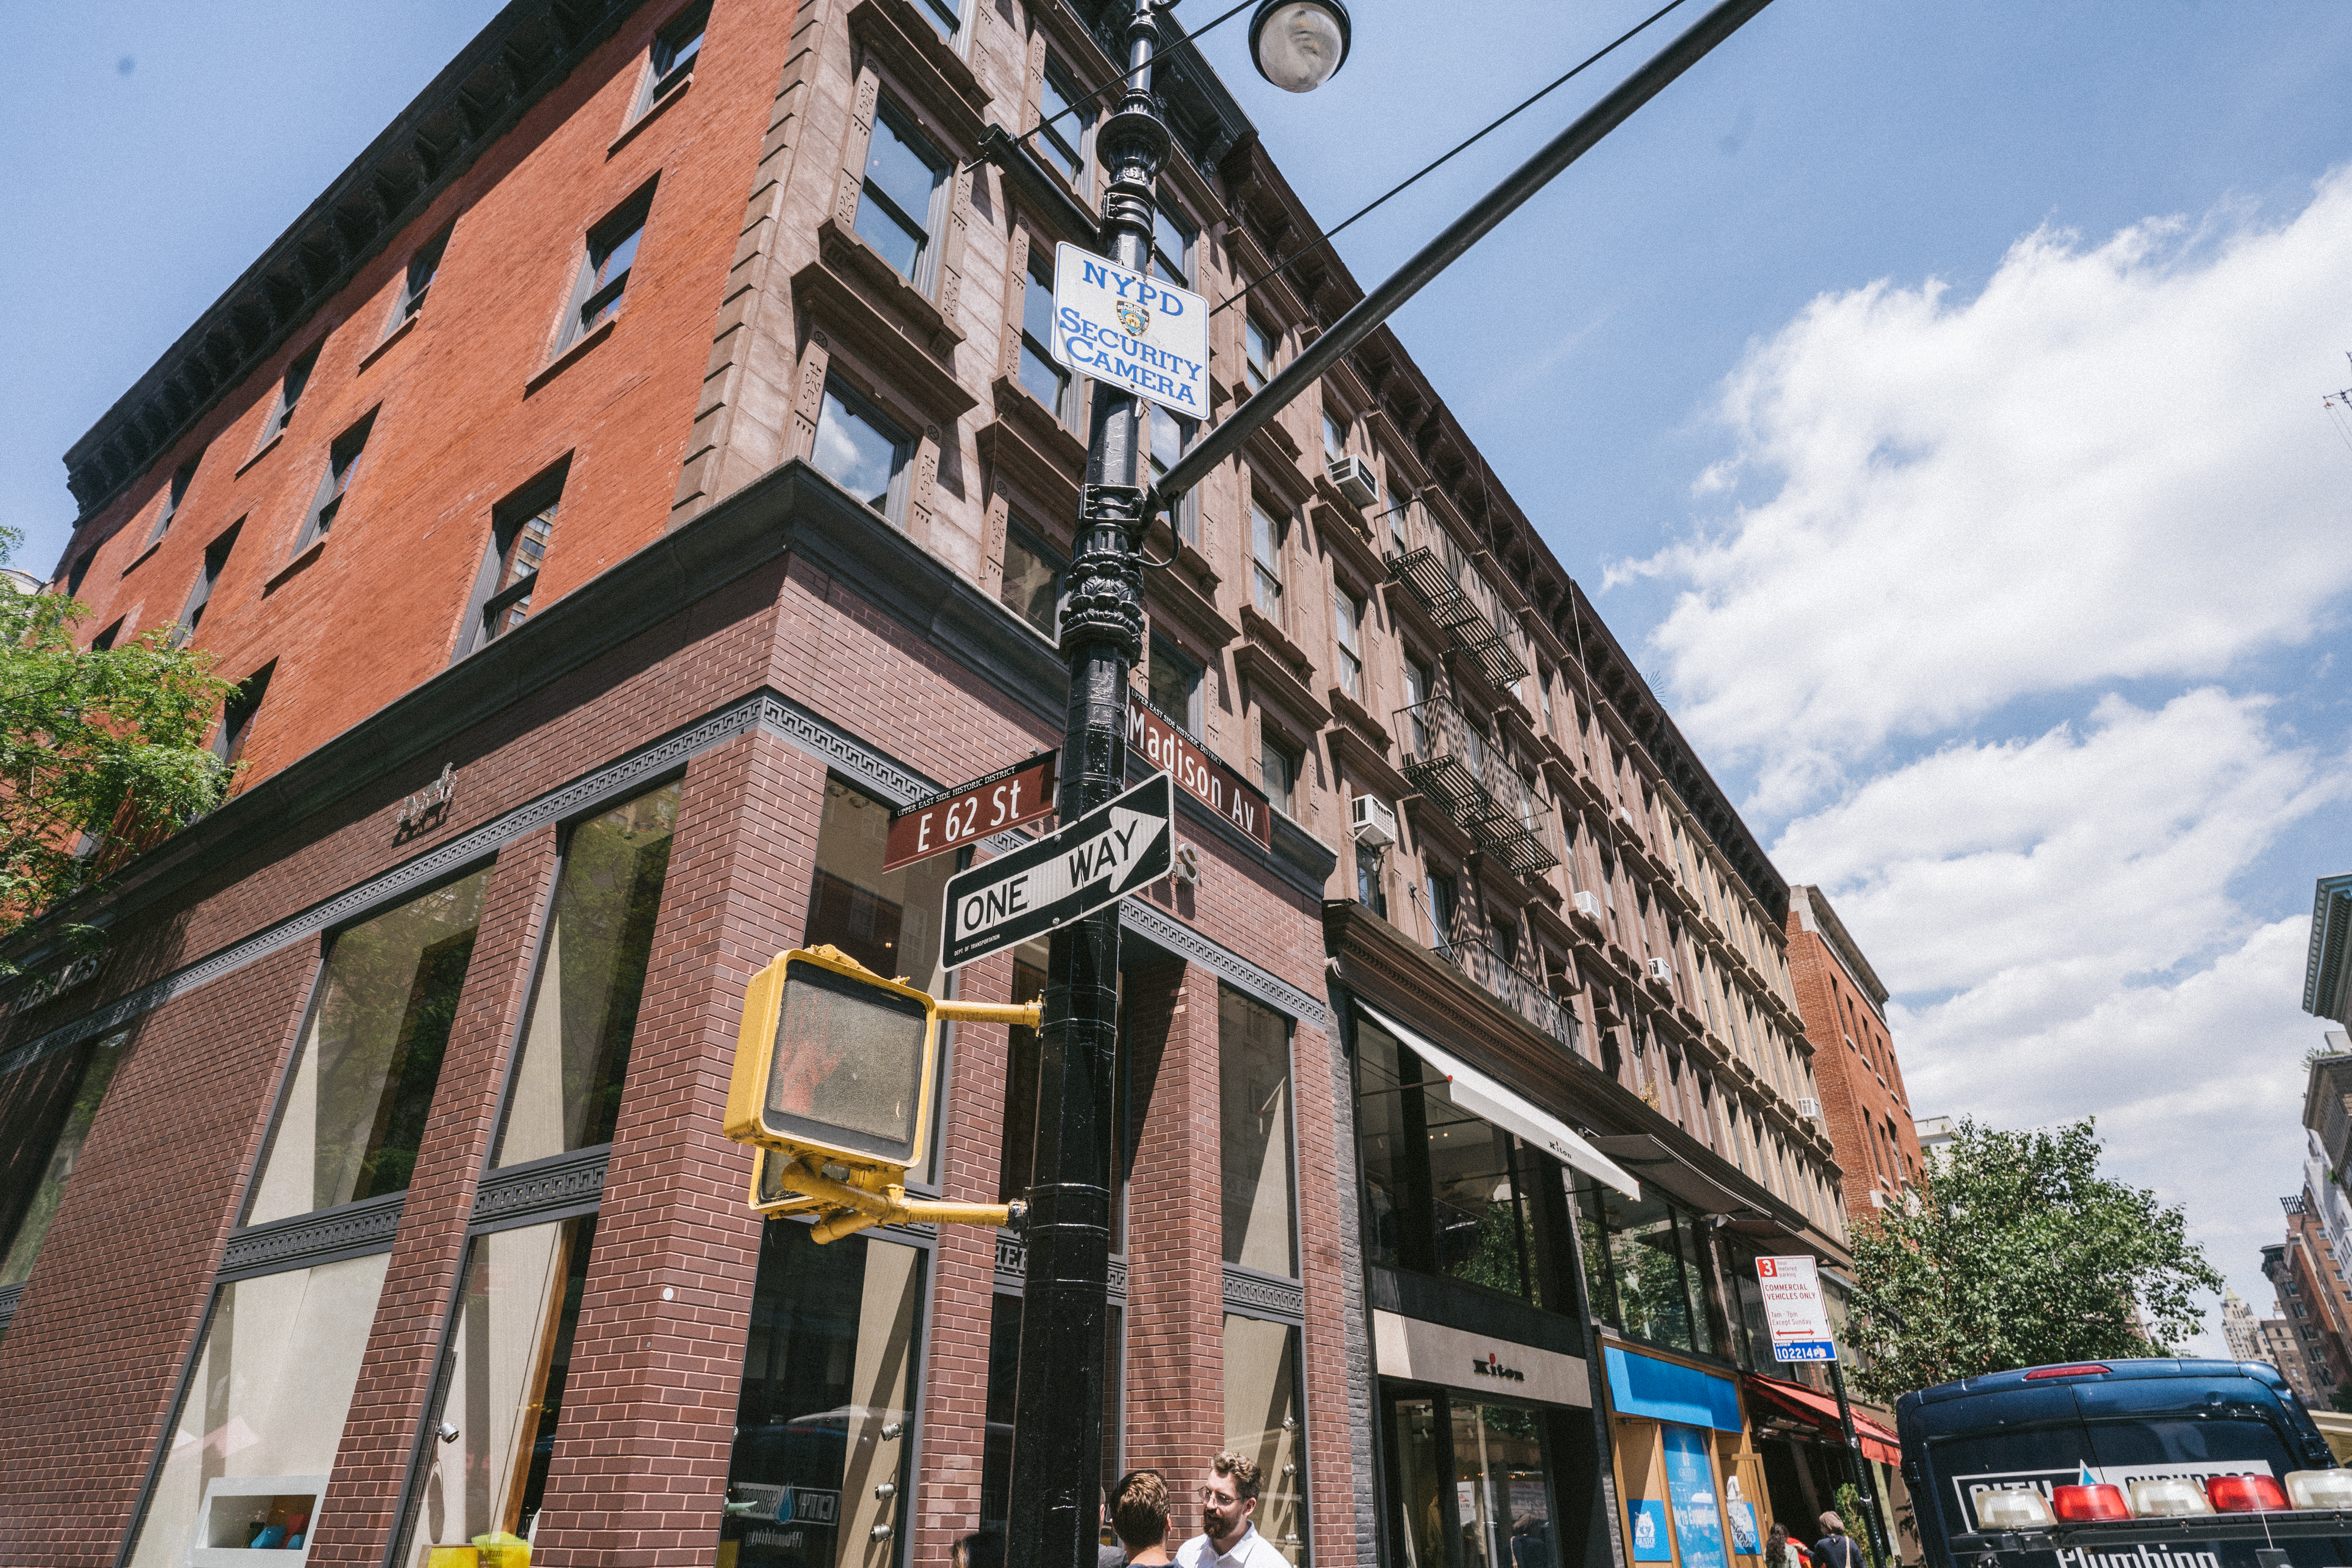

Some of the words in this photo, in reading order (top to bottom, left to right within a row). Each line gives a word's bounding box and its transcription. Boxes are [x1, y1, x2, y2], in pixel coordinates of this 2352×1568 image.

[1083, 260, 1184, 316] NYPD
[1060, 307, 1202, 382] SECURITY
[1066, 336, 1196, 406] CAMERA
[1131, 688, 1148, 707] UPPER
[1149, 703, 1163, 718] EAST
[1163, 714, 1176, 728] SIDE
[1176, 724, 1200, 748] HISTORIC
[1200, 744, 1222, 765] DISTRICT
[897, 805, 917, 817] UPPER
[918, 797, 934, 809] EAST
[936, 791, 950, 803] SIDE
[953, 778, 983, 796] HISTORIC
[984, 766, 1016, 784] DISTRICT
[1130, 705, 1222, 809] Madison
[1232, 788, 1254, 833] Av
[917, 813, 933, 852] E
[946, 797, 978, 842] 62
[990, 780, 1021, 826] St
[964, 874, 1029, 931] ONE
[1068, 819, 1138, 888] WAY
[954, 948, 963, 956] DEPT
[971, 934, 1000, 950] TRANSPORTATION
[1549, 1141, 1572, 1159] Kiton
[1762, 1259, 1773, 1276] 3
[1765, 1283, 1808, 1292] COMMERCIAL
[1473, 1353, 1525, 1381] Kiton
[1776, 1348, 1813, 1359] 102214
